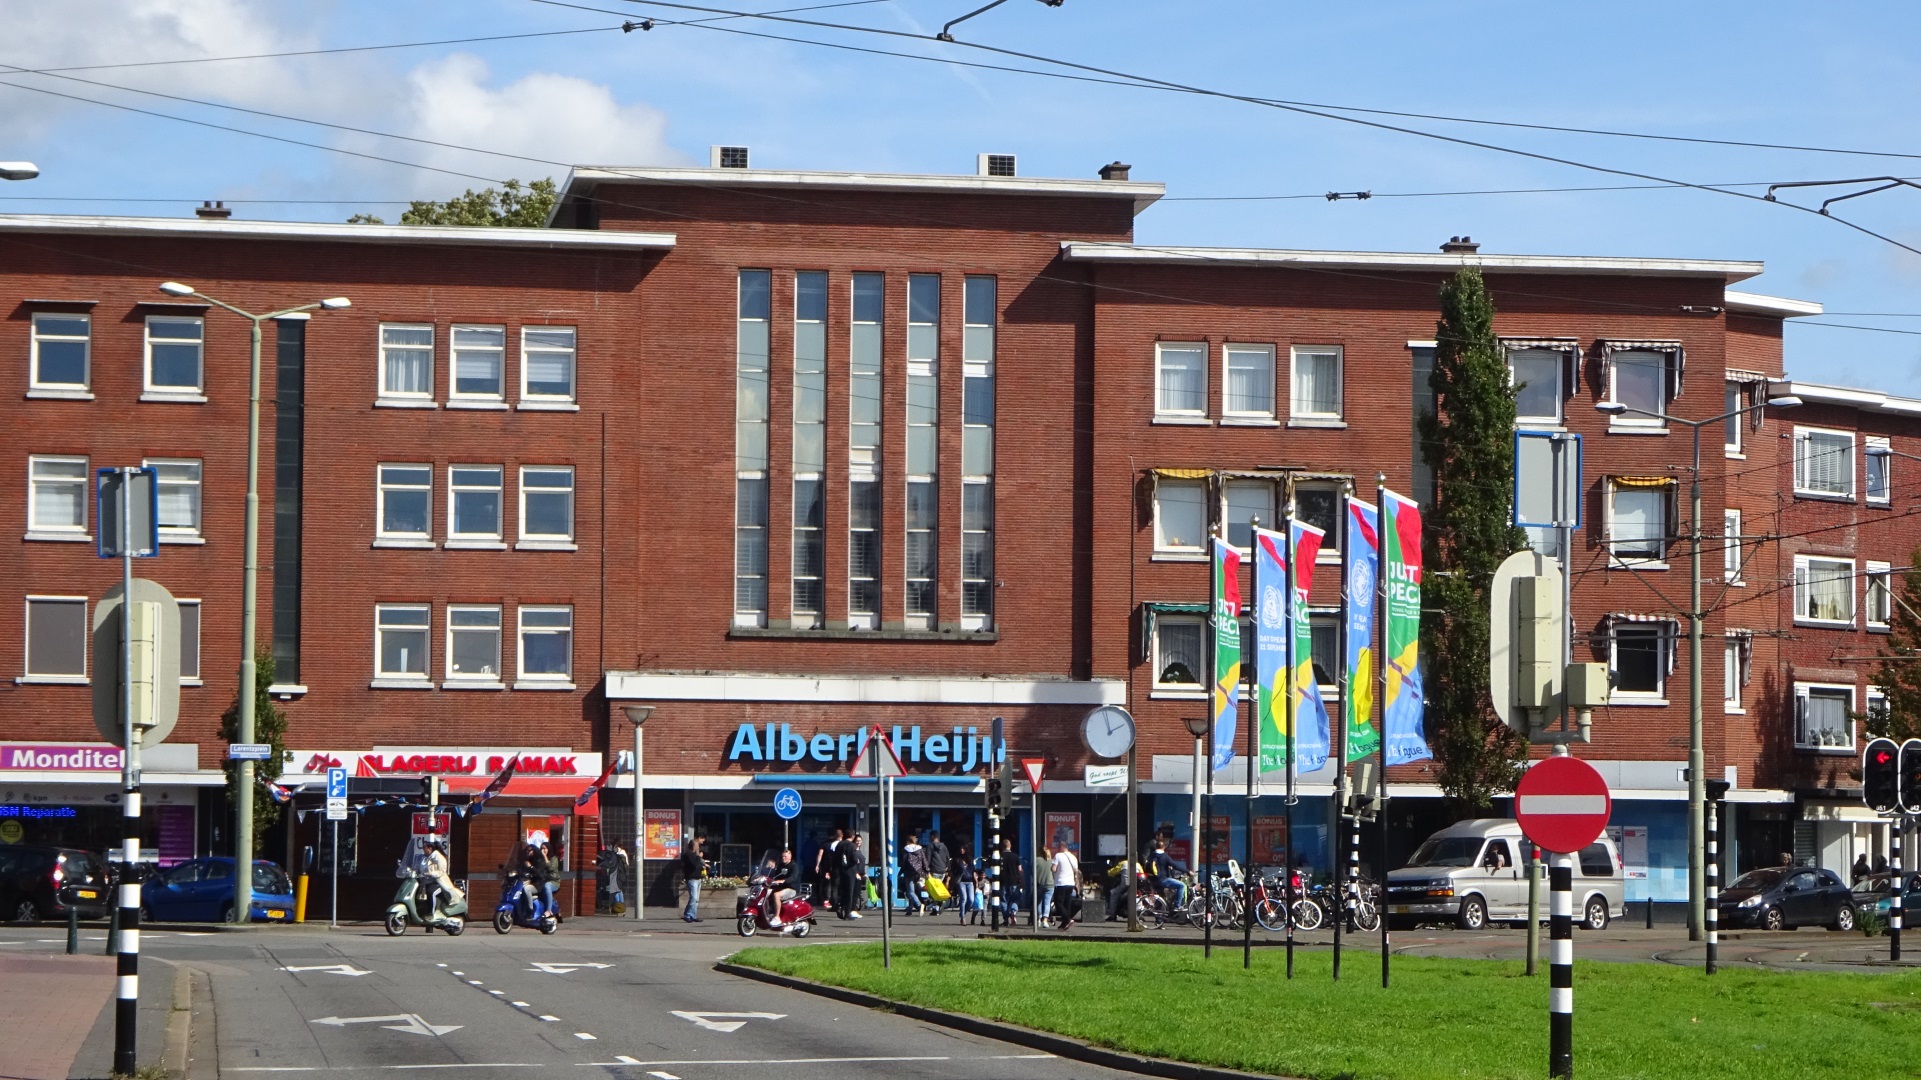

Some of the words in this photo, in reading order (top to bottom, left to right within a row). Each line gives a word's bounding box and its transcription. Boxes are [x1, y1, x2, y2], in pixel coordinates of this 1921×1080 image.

[12, 749, 126, 769] Monditel
[489, 756, 577, 773] RAMAK
[648, 811, 676, 819] BONUS
[1201, 817, 1227, 825] BNUS
